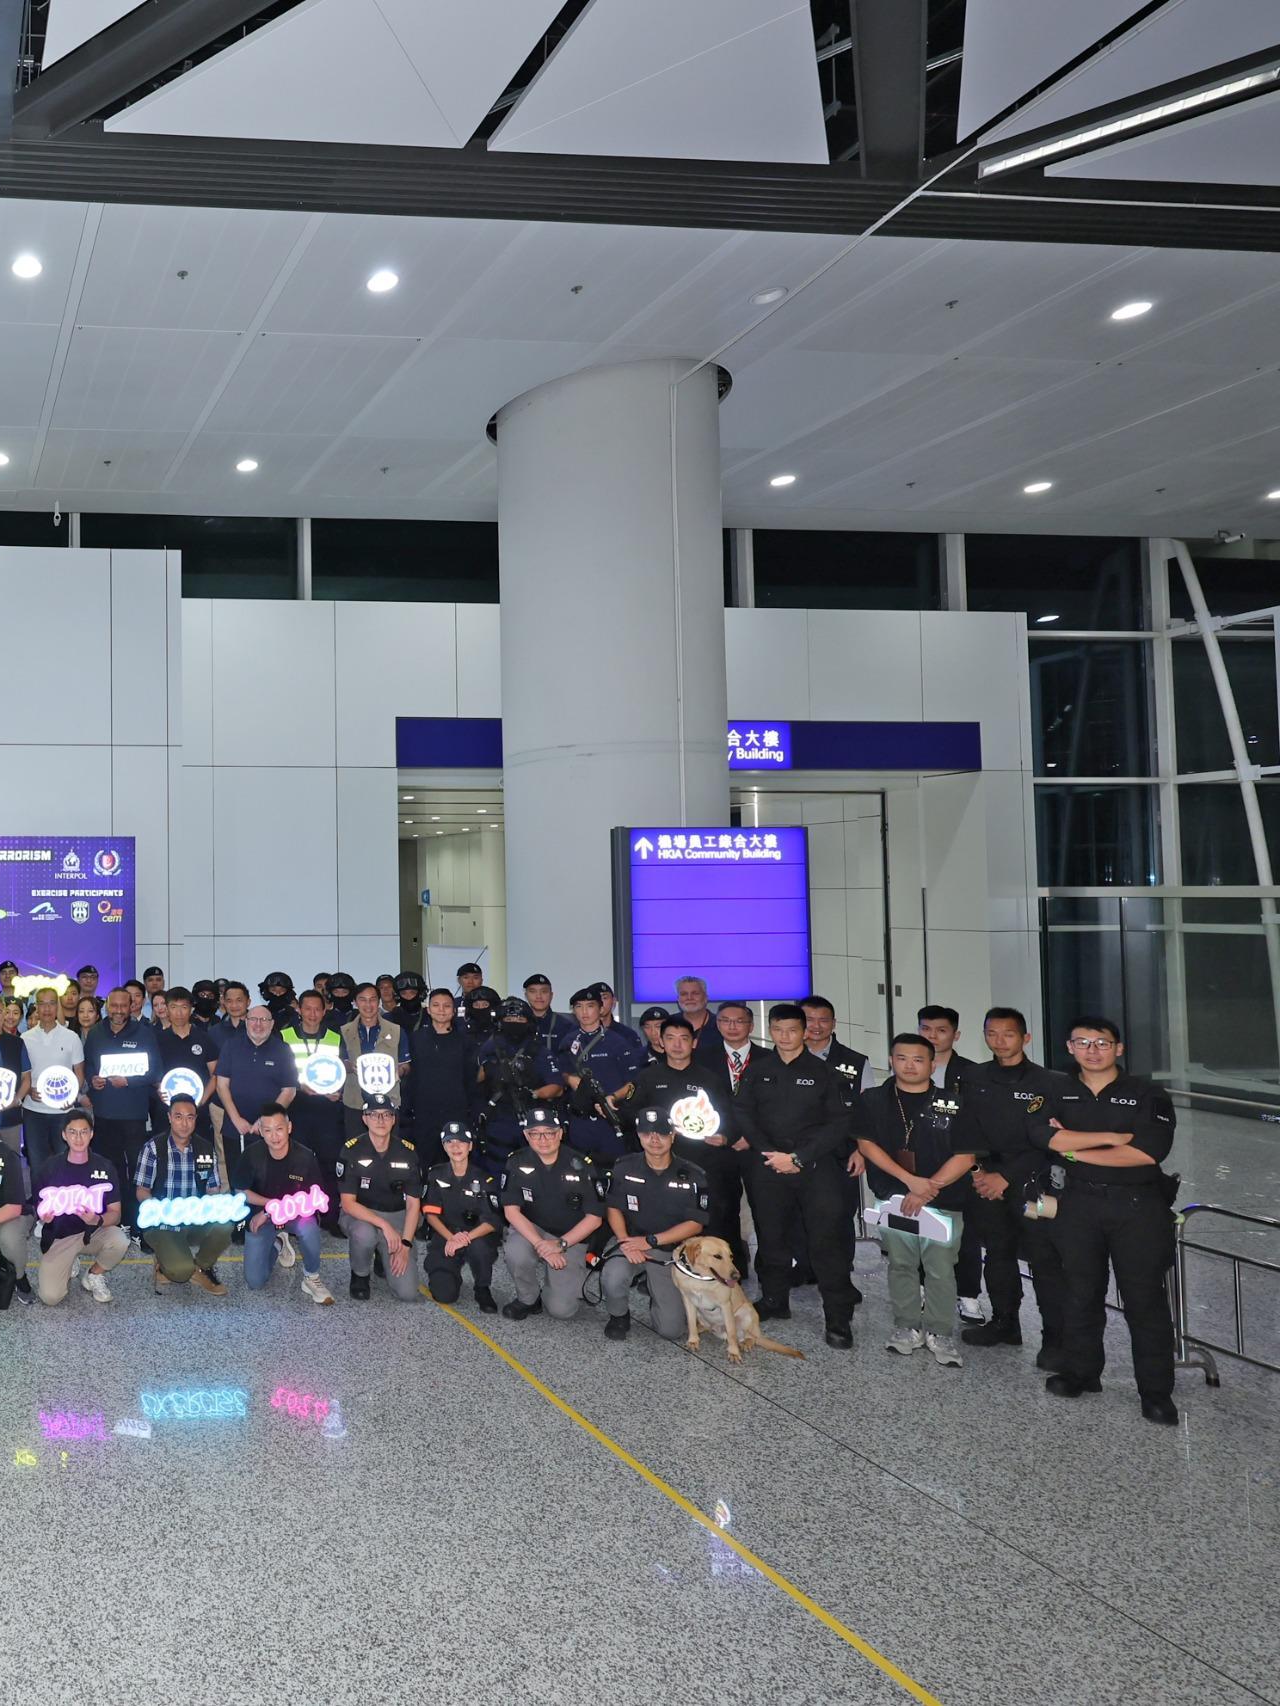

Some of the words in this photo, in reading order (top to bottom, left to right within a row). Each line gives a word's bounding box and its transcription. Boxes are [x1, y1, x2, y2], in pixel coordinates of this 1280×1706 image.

[736, 748, 784, 763] Building
[658, 850, 683, 860] HKIA
[684, 849, 740, 861] Community
[743, 849, 782, 861] Building
[54, 872, 88, 880] INTERPOL
[31, 889, 68, 897] EXERCISE
[70, 889, 124, 897] PARTICIPANTS
[102, 914, 123, 923] cem
[101, 1063, 145, 1076] KPMG
[265, 1184, 330, 1225] 2024
